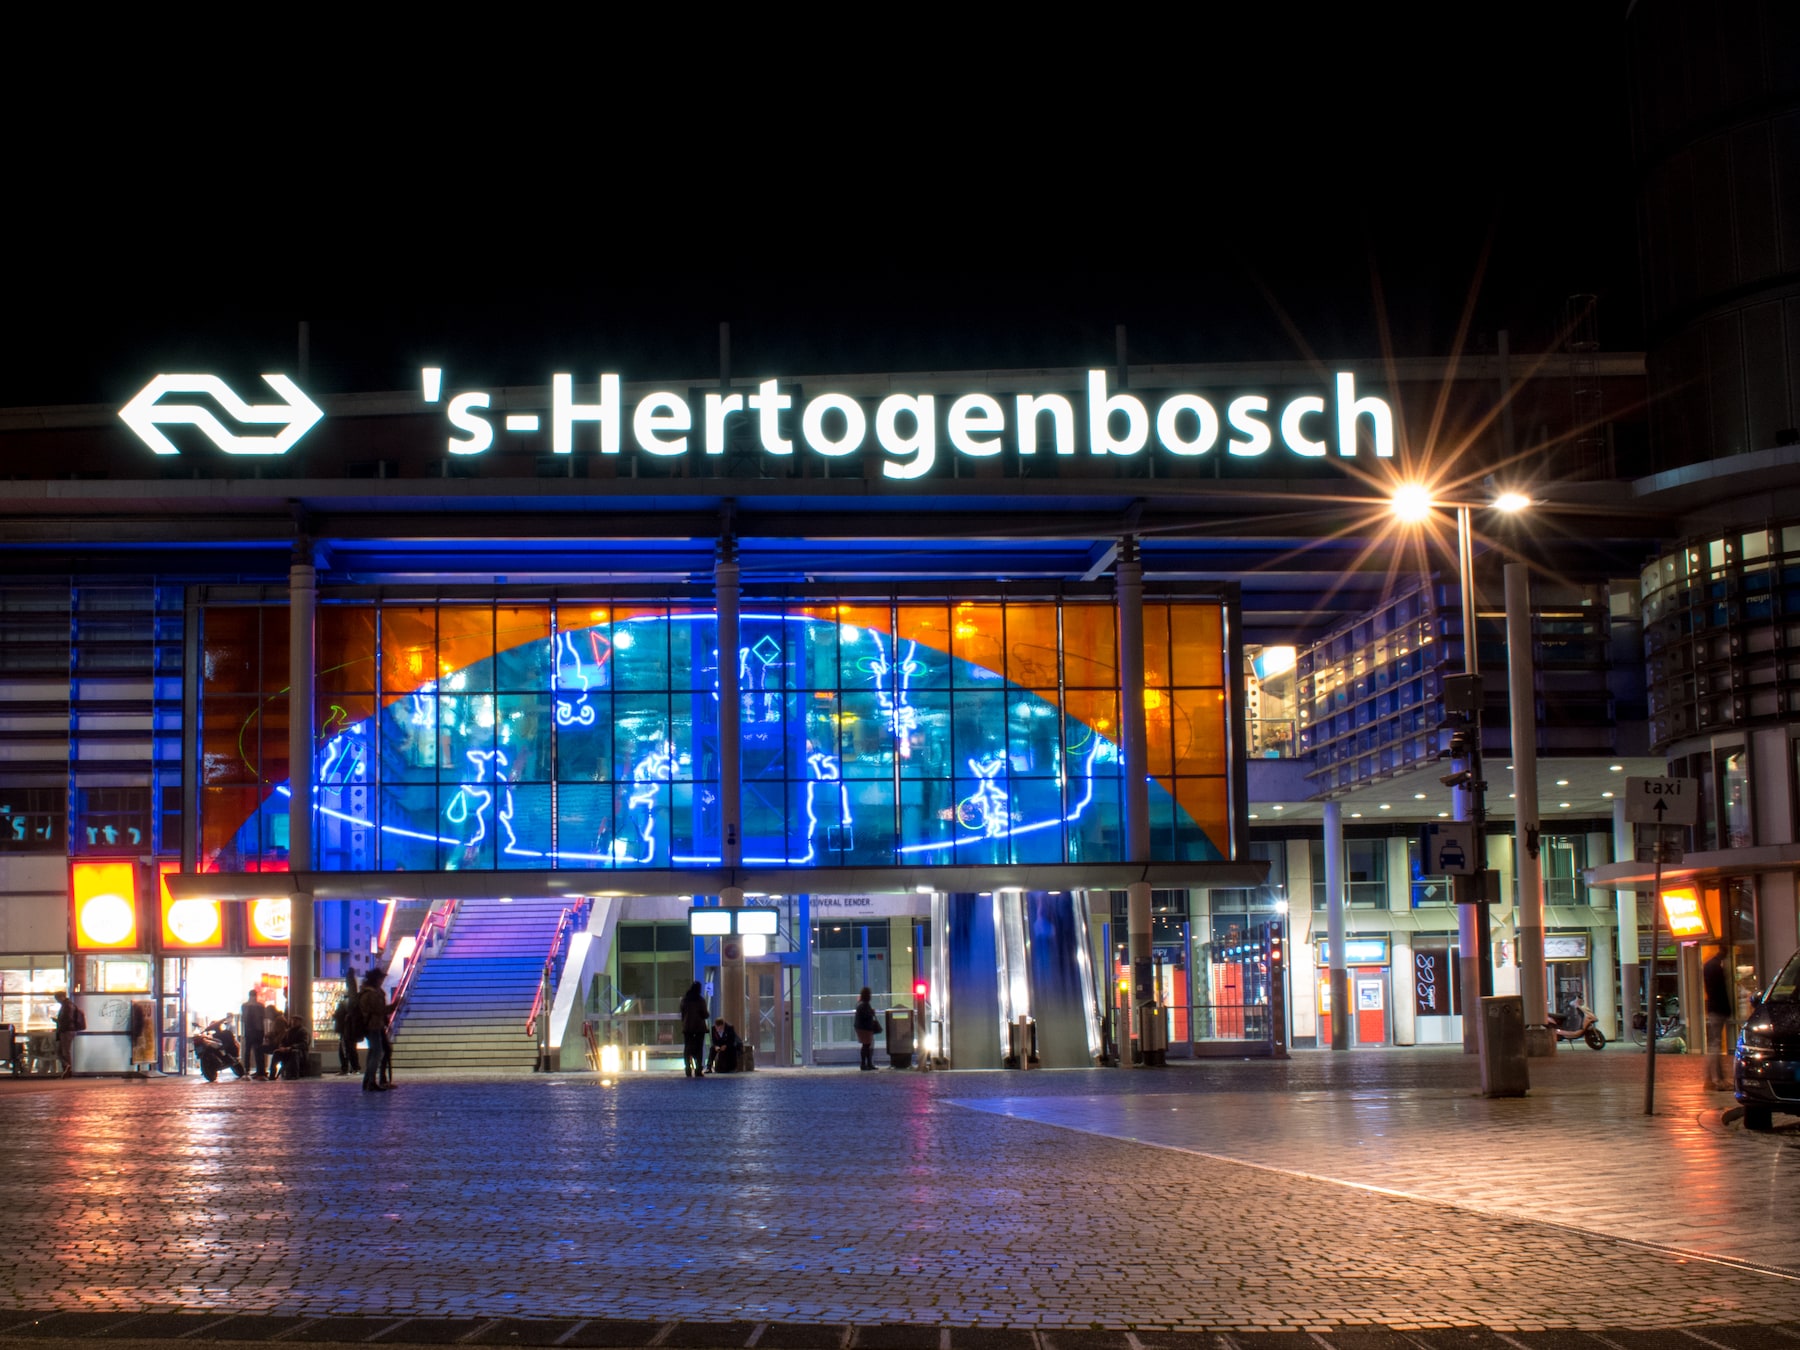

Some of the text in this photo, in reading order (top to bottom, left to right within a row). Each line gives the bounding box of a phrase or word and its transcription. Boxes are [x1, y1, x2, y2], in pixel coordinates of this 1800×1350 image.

[421, 367, 1393, 480] 's-Hertogenbosch
[1644, 780, 1681, 796] taxi
[1415, 953, 1436, 1010] 1868
